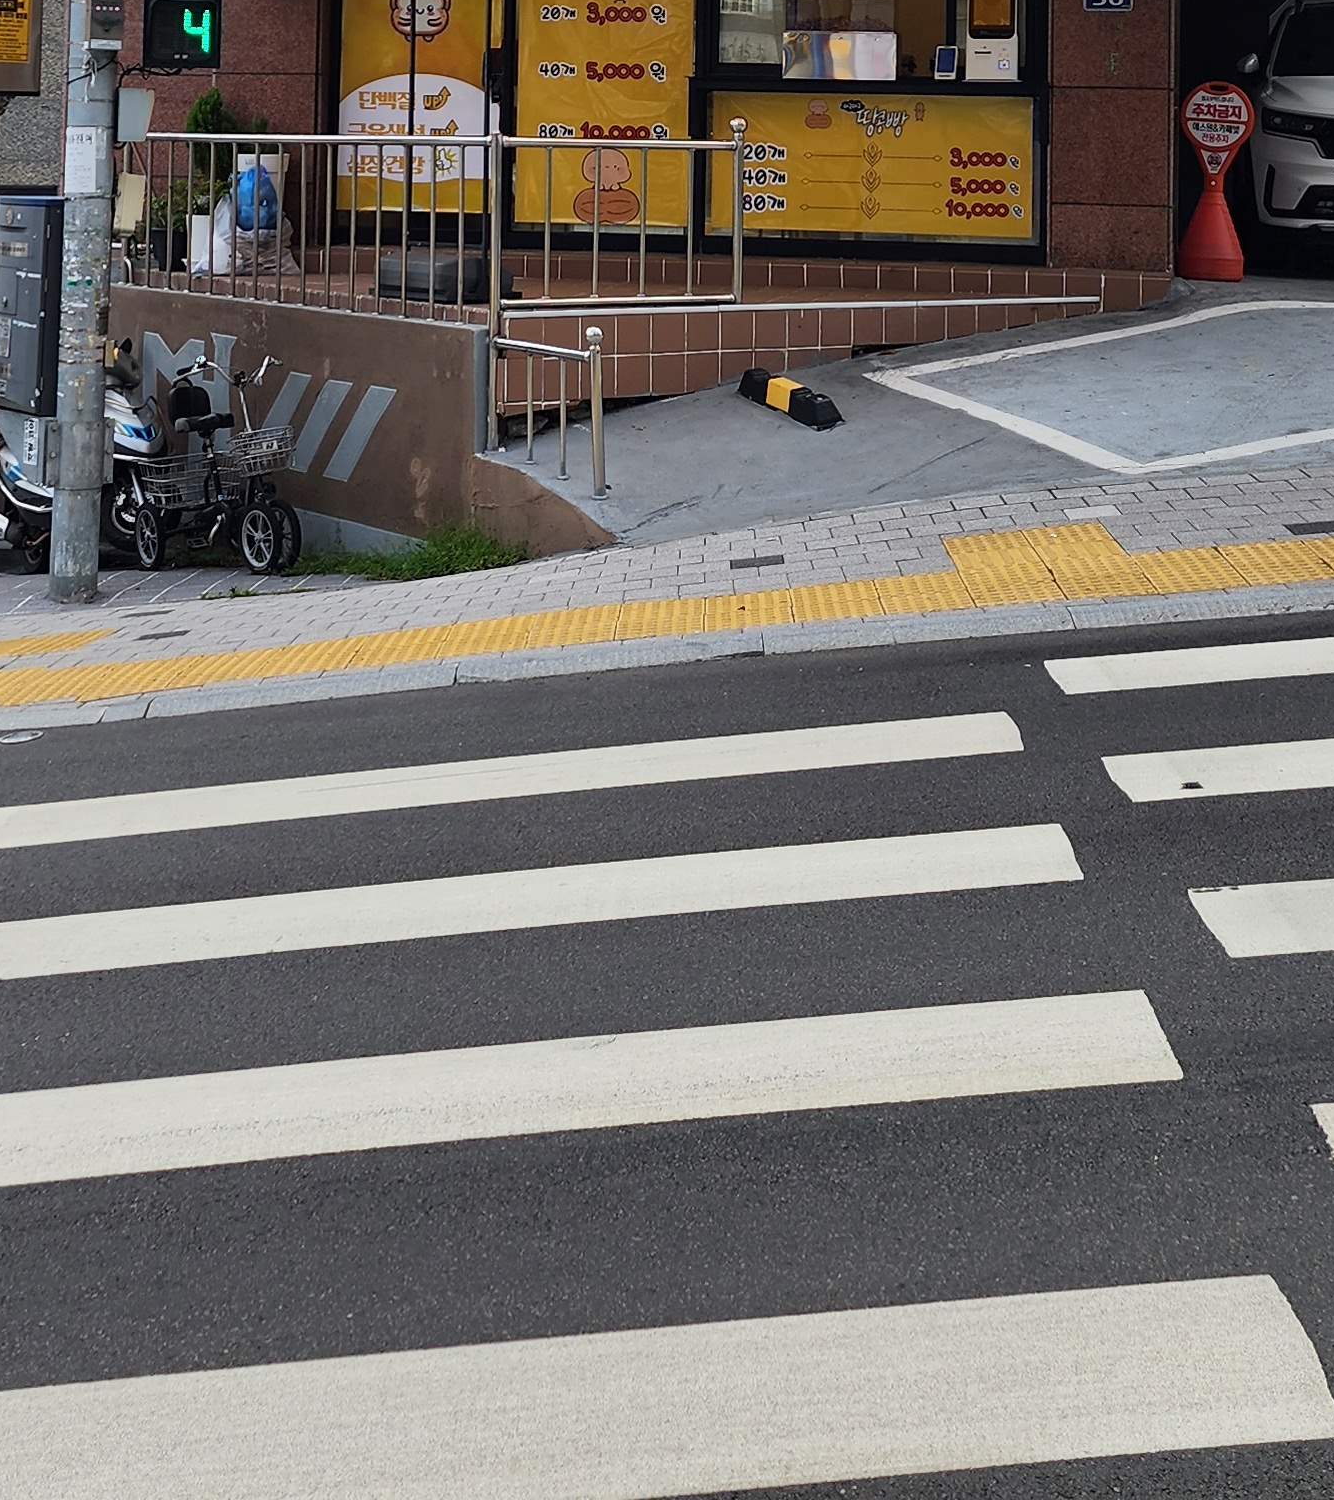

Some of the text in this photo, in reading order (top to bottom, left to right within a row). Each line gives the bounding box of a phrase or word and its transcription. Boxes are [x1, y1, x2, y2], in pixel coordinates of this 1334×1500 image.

[540, 2, 667, 26] 20개 3,000 원
[183, 8, 211, 53] 4
[538, 61, 666, 83] 40개 5,000 원
[856, 107, 909, 137] 땅콩빵
[1192, 103, 1243, 119] 주차금지
[743, 144, 787, 161] 20개
[949, 147, 1008, 169] 3,000
[742, 169, 787, 186] 40개
[949, 176, 1006, 197] 5,000
[742, 194, 786, 212] 80개
[945, 198, 1010, 220] 10,000
